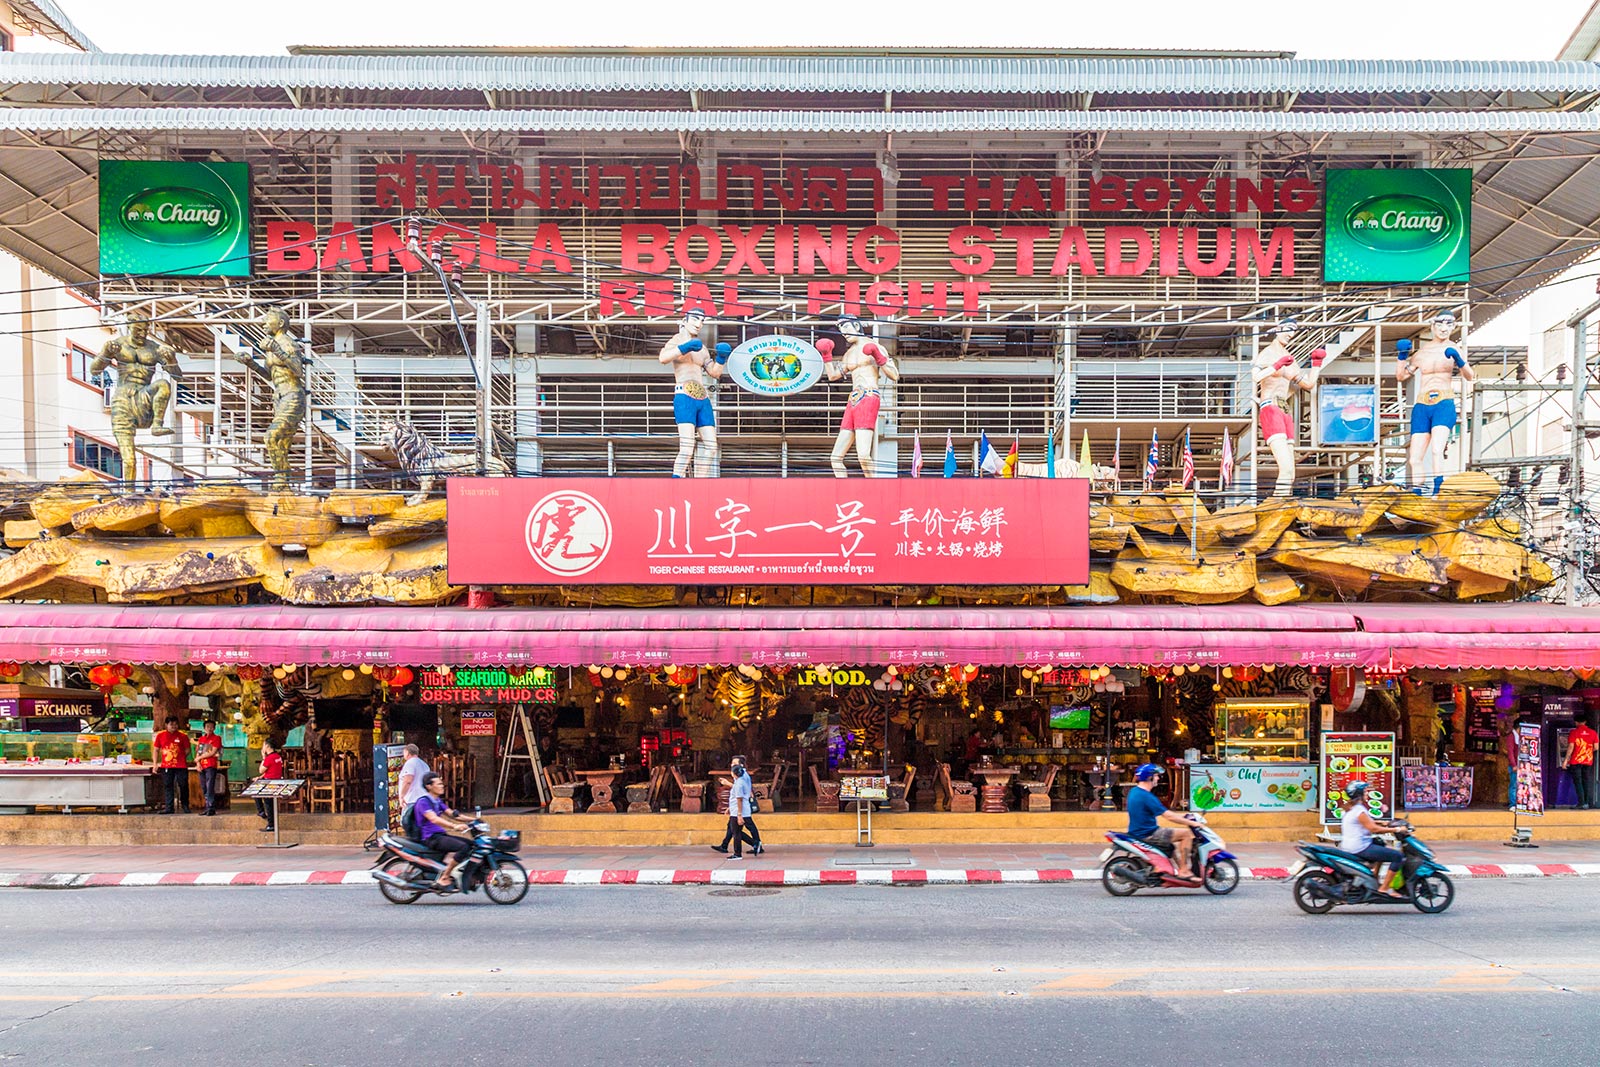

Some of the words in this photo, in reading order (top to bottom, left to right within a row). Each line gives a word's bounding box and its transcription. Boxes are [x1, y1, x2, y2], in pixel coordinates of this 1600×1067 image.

[375, 153, 884, 212] สนามมวยบางลา
[921, 175, 1066, 212] THAI
[1089, 176, 1317, 213] BOXING
[157, 203, 221, 227] Chang
[1381, 210, 1444, 233] Chang
[266, 220, 574, 273] BANGLA
[621, 223, 900, 275] BOXING
[948, 225, 1294, 277] STADIUM
[600, 280, 754, 317] REAL
[807, 280, 991, 317] FIGHT
[1321, 394, 1374, 408] PEPSI
[647, 498, 876, 558] 川字一号
[890, 507, 1008, 538] 平价海鲜
[649, 565, 671, 575] TIGER
[672, 565, 705, 574] CHINESE
[708, 565, 755, 574] RESTAURANT
[422, 671, 454, 686] TIGER
[456, 671, 507, 686] SEAFOOD
[422, 689, 481, 701] OBSTER
[498, 690, 531, 700] MUD
[535, 690, 555, 701] CR
[35, 705, 93, 716] EXCHANGE
[1544, 703, 1562, 711] ATM
[1530, 740, 1538, 757] 3
[1238, 768, 1262, 784] Chef
